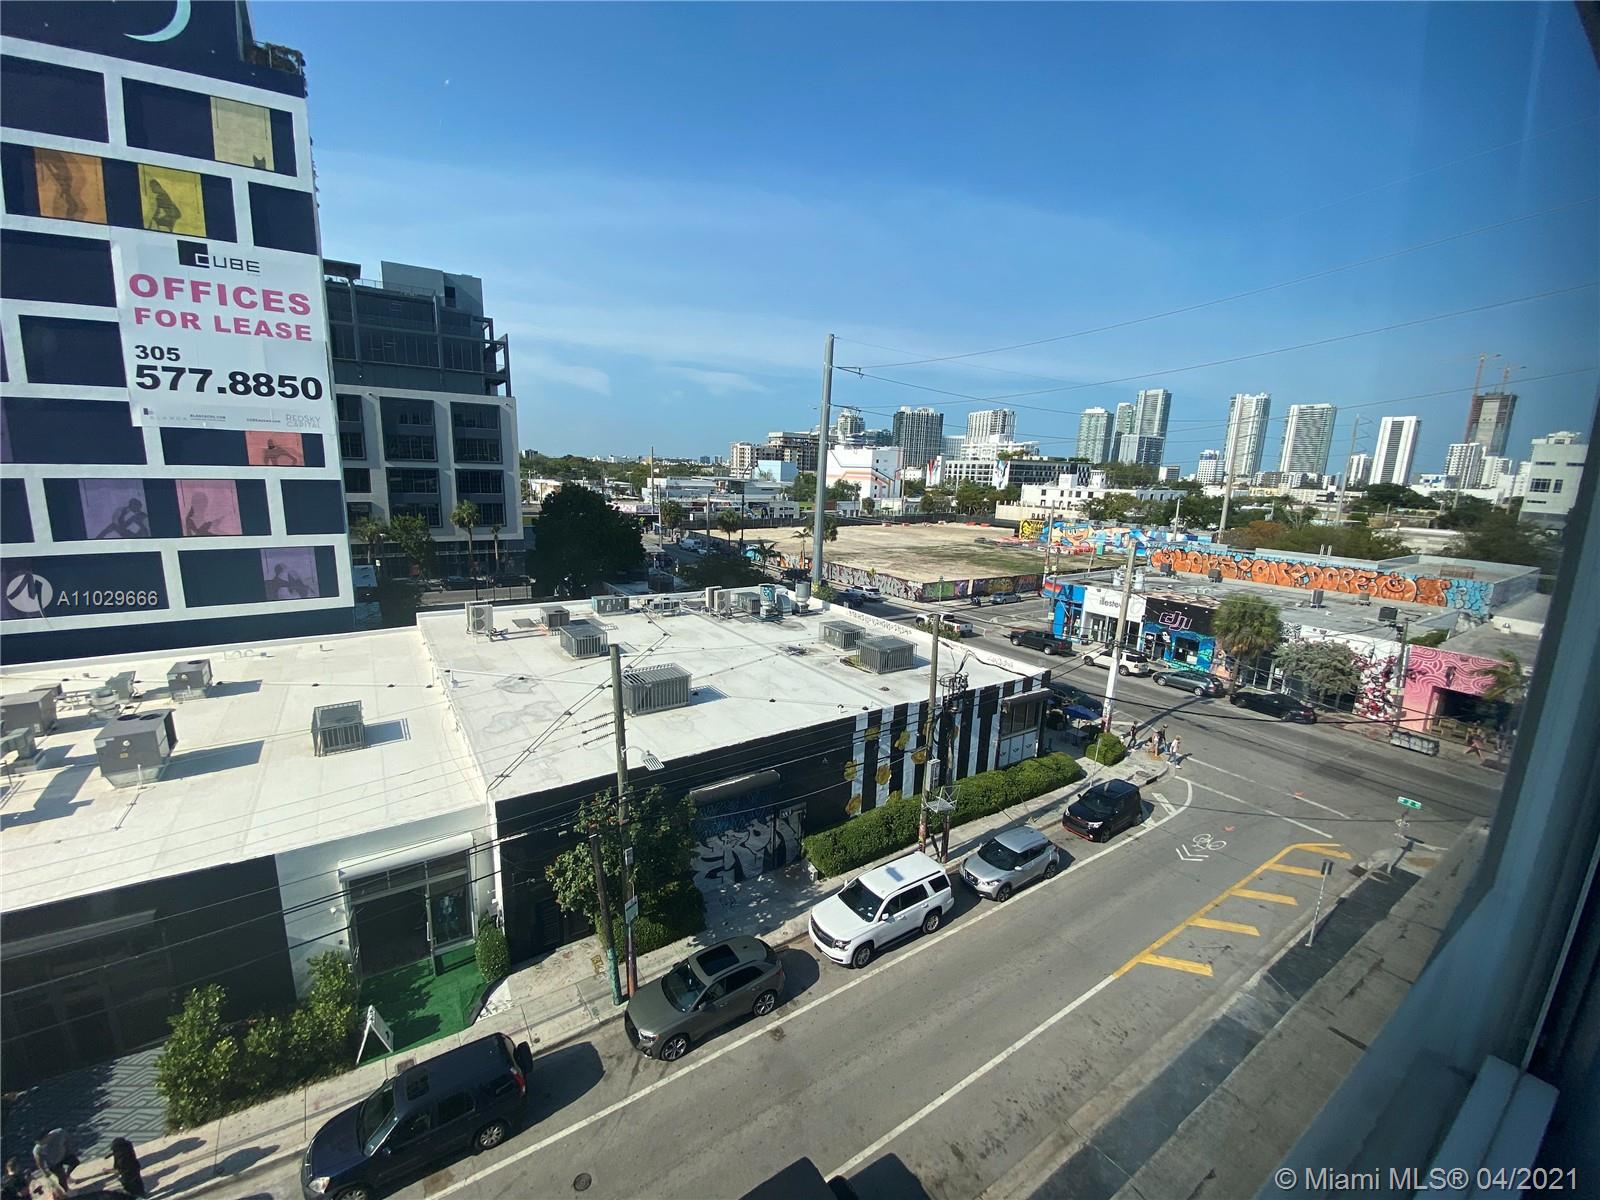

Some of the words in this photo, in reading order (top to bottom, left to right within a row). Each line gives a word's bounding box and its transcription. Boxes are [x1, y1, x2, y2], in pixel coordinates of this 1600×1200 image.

[195, 253, 260, 273] CUBE
[129, 273, 311, 316] OFFICES
[134, 307, 202, 331] FOR
[213, 315, 312, 341] LEASE
[135, 345, 181, 362] 305
[135, 364, 323, 400] 577.8850
